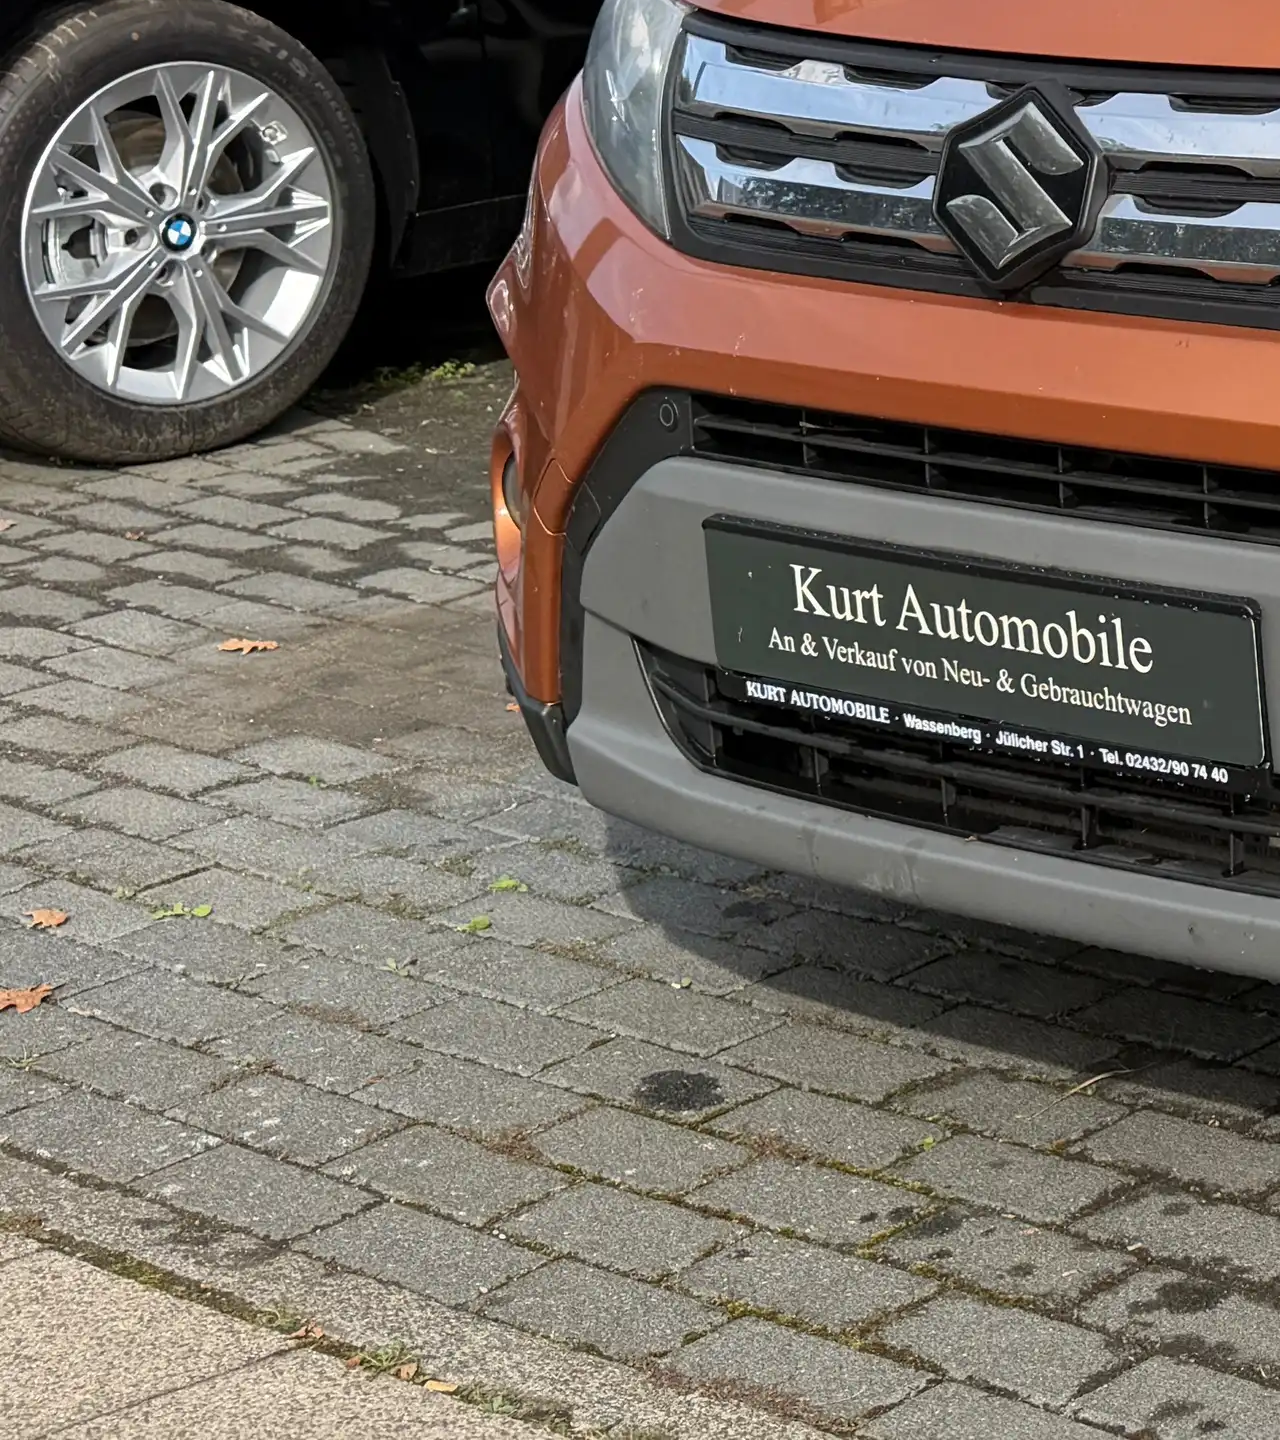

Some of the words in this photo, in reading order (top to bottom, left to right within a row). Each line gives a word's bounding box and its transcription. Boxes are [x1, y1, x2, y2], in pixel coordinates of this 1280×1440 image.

[789, 563, 887, 627] Kurt
[895, 583, 1154, 674] Automobile
[768, 626, 796, 657] An
[800, 632, 819, 657] &
[821, 636, 899, 672] Verkauf
[900, 657, 938, 680] von
[940, 657, 991, 688] Neu-
[995, 668, 1016, 694] &
[1020, 672, 1193, 728] Gebrauchtwagen
[745, 680, 787, 705] KURT
[790, 689, 891, 725] AUTOMOBILE
[902, 712, 982, 744] Wassenberg
[994, 729, 1049, 754] Jülicher
[1050, 739, 1075, 759] Str.
[1076, 744, 1085, 760] 1
[1098, 747, 1124, 767] Tel.
[1125, 751, 1190, 778] 02432/90
[1191, 763, 1209, 781] 74
[1210, 766, 1229, 784] 40
